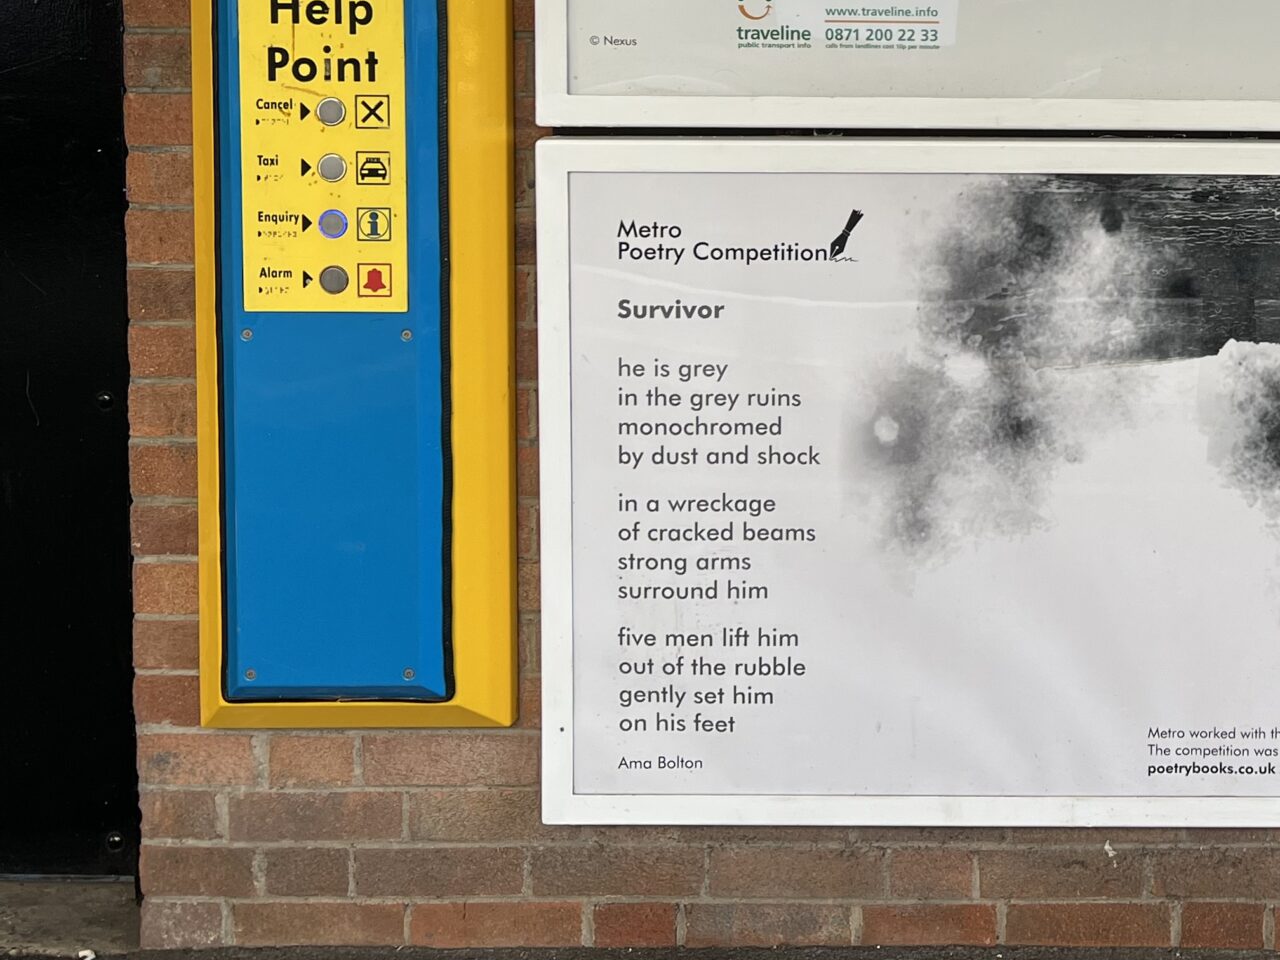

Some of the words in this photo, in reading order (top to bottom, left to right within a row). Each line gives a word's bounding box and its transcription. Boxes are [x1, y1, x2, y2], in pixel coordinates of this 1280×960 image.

[825, 6, 938, 18] www.traveline.info
[603, 35, 637, 46] Nexus
[737, 26, 811, 41] traveline
[825, 29, 859, 40] 0871
[866, 29, 892, 41] 200
[897, 29, 915, 41] 22
[921, 30, 938, 41] 33
[268, 46, 378, 82] Point
[256, 99, 292, 109] Cancel
[257, 155, 278, 165] Taxi
[258, 211, 299, 224] Enquiry
[617, 220, 681, 238] Metro
[618, 242, 685, 264] Poetry
[693, 242, 827, 265] Competition
[259, 267, 292, 278] Alarm
[618, 300, 724, 319] Survivor
[618, 358, 645, 376] he
[654, 359, 669, 376] is
[679, 362, 728, 381] grey
[618, 388, 637, 406] in
[647, 388, 681, 406] the
[691, 392, 739, 411] grey
[748, 389, 801, 406] ruins
[618, 417, 782, 435] monochromed
[618, 446, 643, 469] by
[652, 446, 698, 464] dust
[707, 446, 748, 465] and
[757, 446, 820, 465] shock
[1148, 728, 1185, 739] Metro
[1189, 728, 1236, 739] worked
[1240, 728, 1266, 739] with
[618, 757, 651, 769] Ama
[658, 756, 703, 769] Bolton
[1148, 762, 1276, 776] poetrybooks.co.uk
